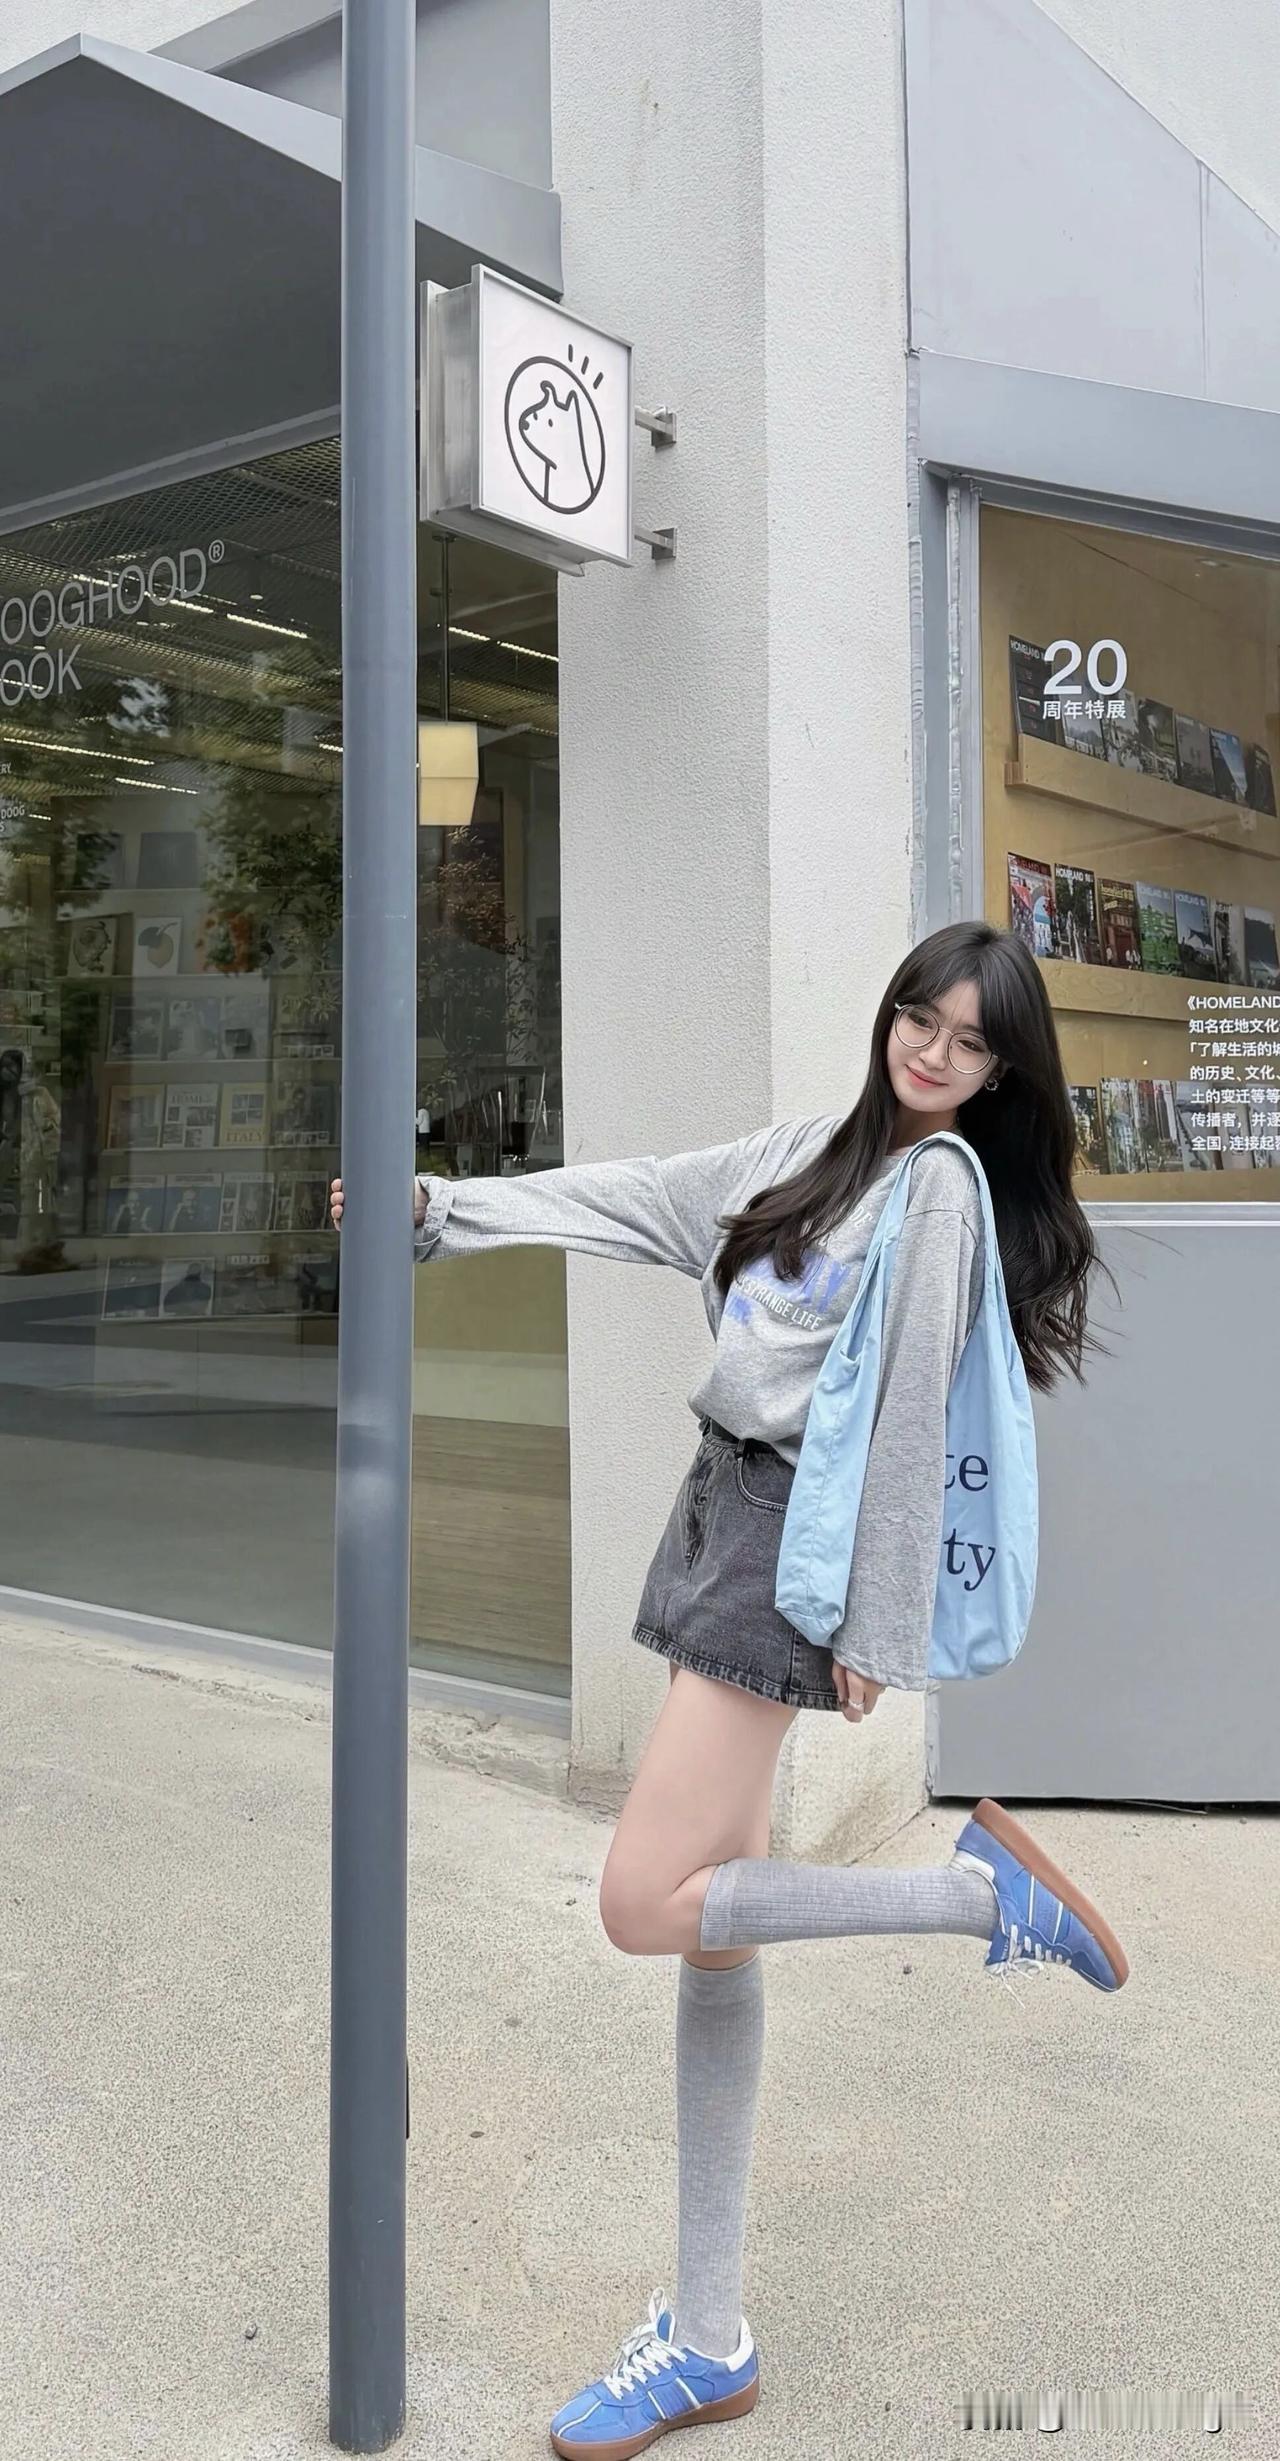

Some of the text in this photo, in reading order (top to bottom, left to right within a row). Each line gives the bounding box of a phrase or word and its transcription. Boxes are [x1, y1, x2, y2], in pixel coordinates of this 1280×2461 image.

[0, 643, 82, 706] OOK
[1042, 639, 1128, 695] 20
[1042, 700, 1127, 720] 周年特展
[1190, 1088, 1280, 1104] 土的变迁等等
[791, 1307, 823, 1331] LIFE
[943, 1528, 996, 1591] ty
